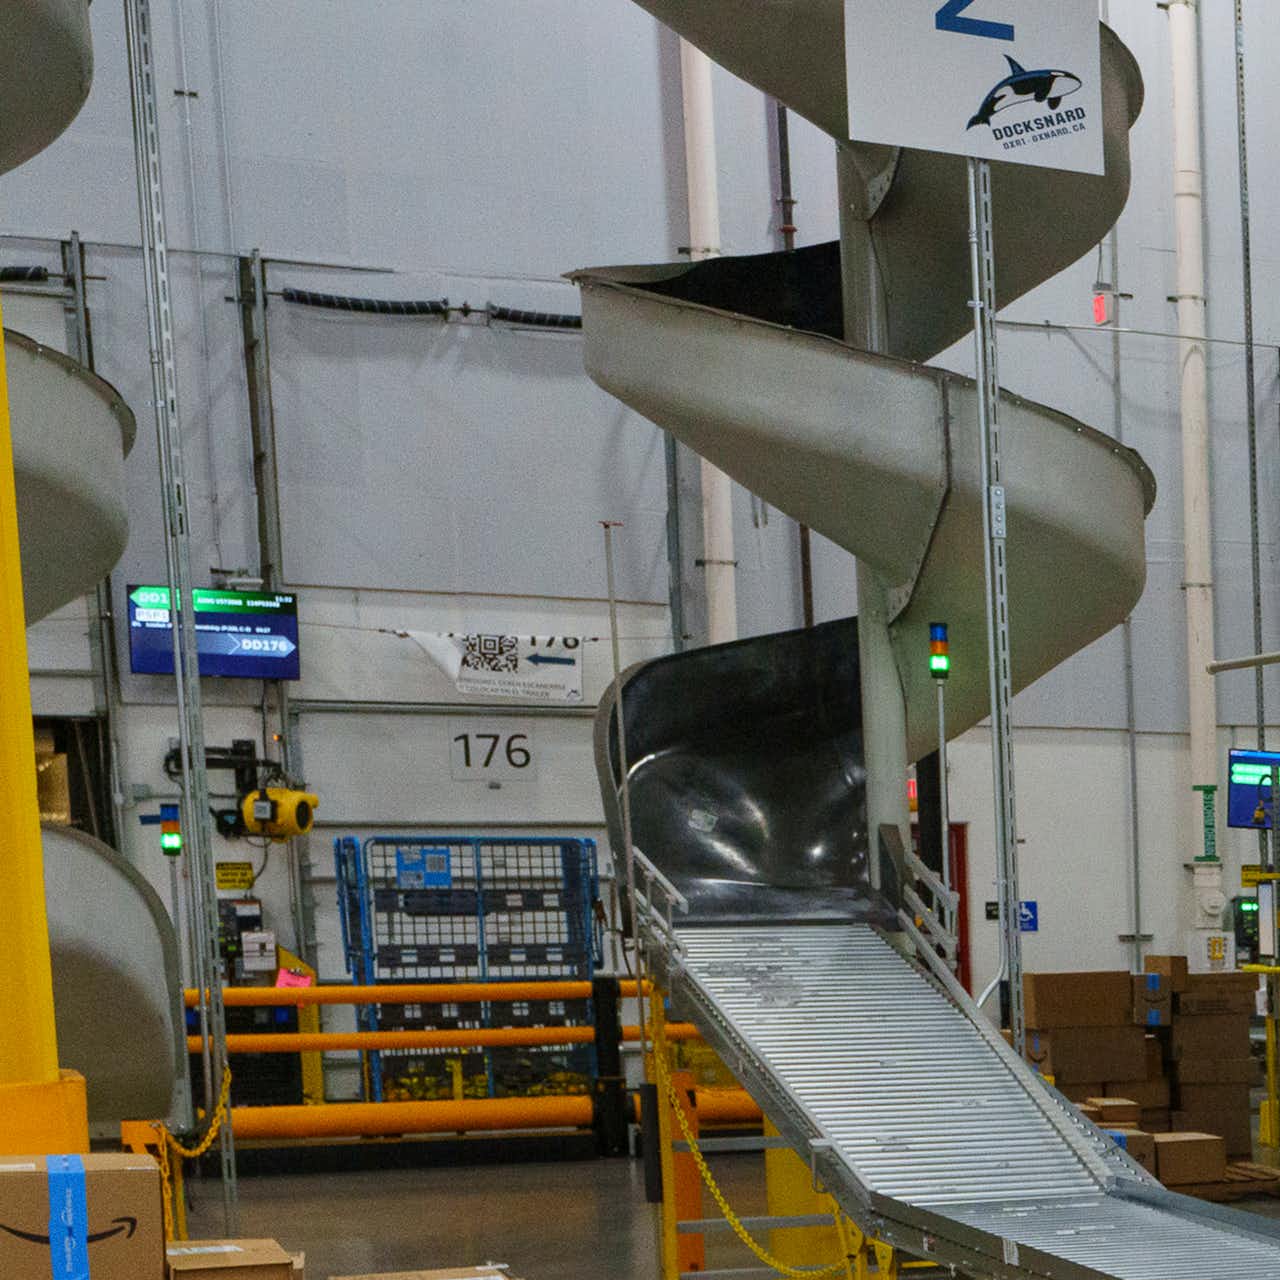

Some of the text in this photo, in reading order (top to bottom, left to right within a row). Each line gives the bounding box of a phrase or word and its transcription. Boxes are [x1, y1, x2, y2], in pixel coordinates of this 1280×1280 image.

[992, 107, 1086, 141] DOCKSNARD
[1072, 124, 1086, 134] CA
[241, 638, 288, 652] DD176
[454, 734, 531, 768] 176
